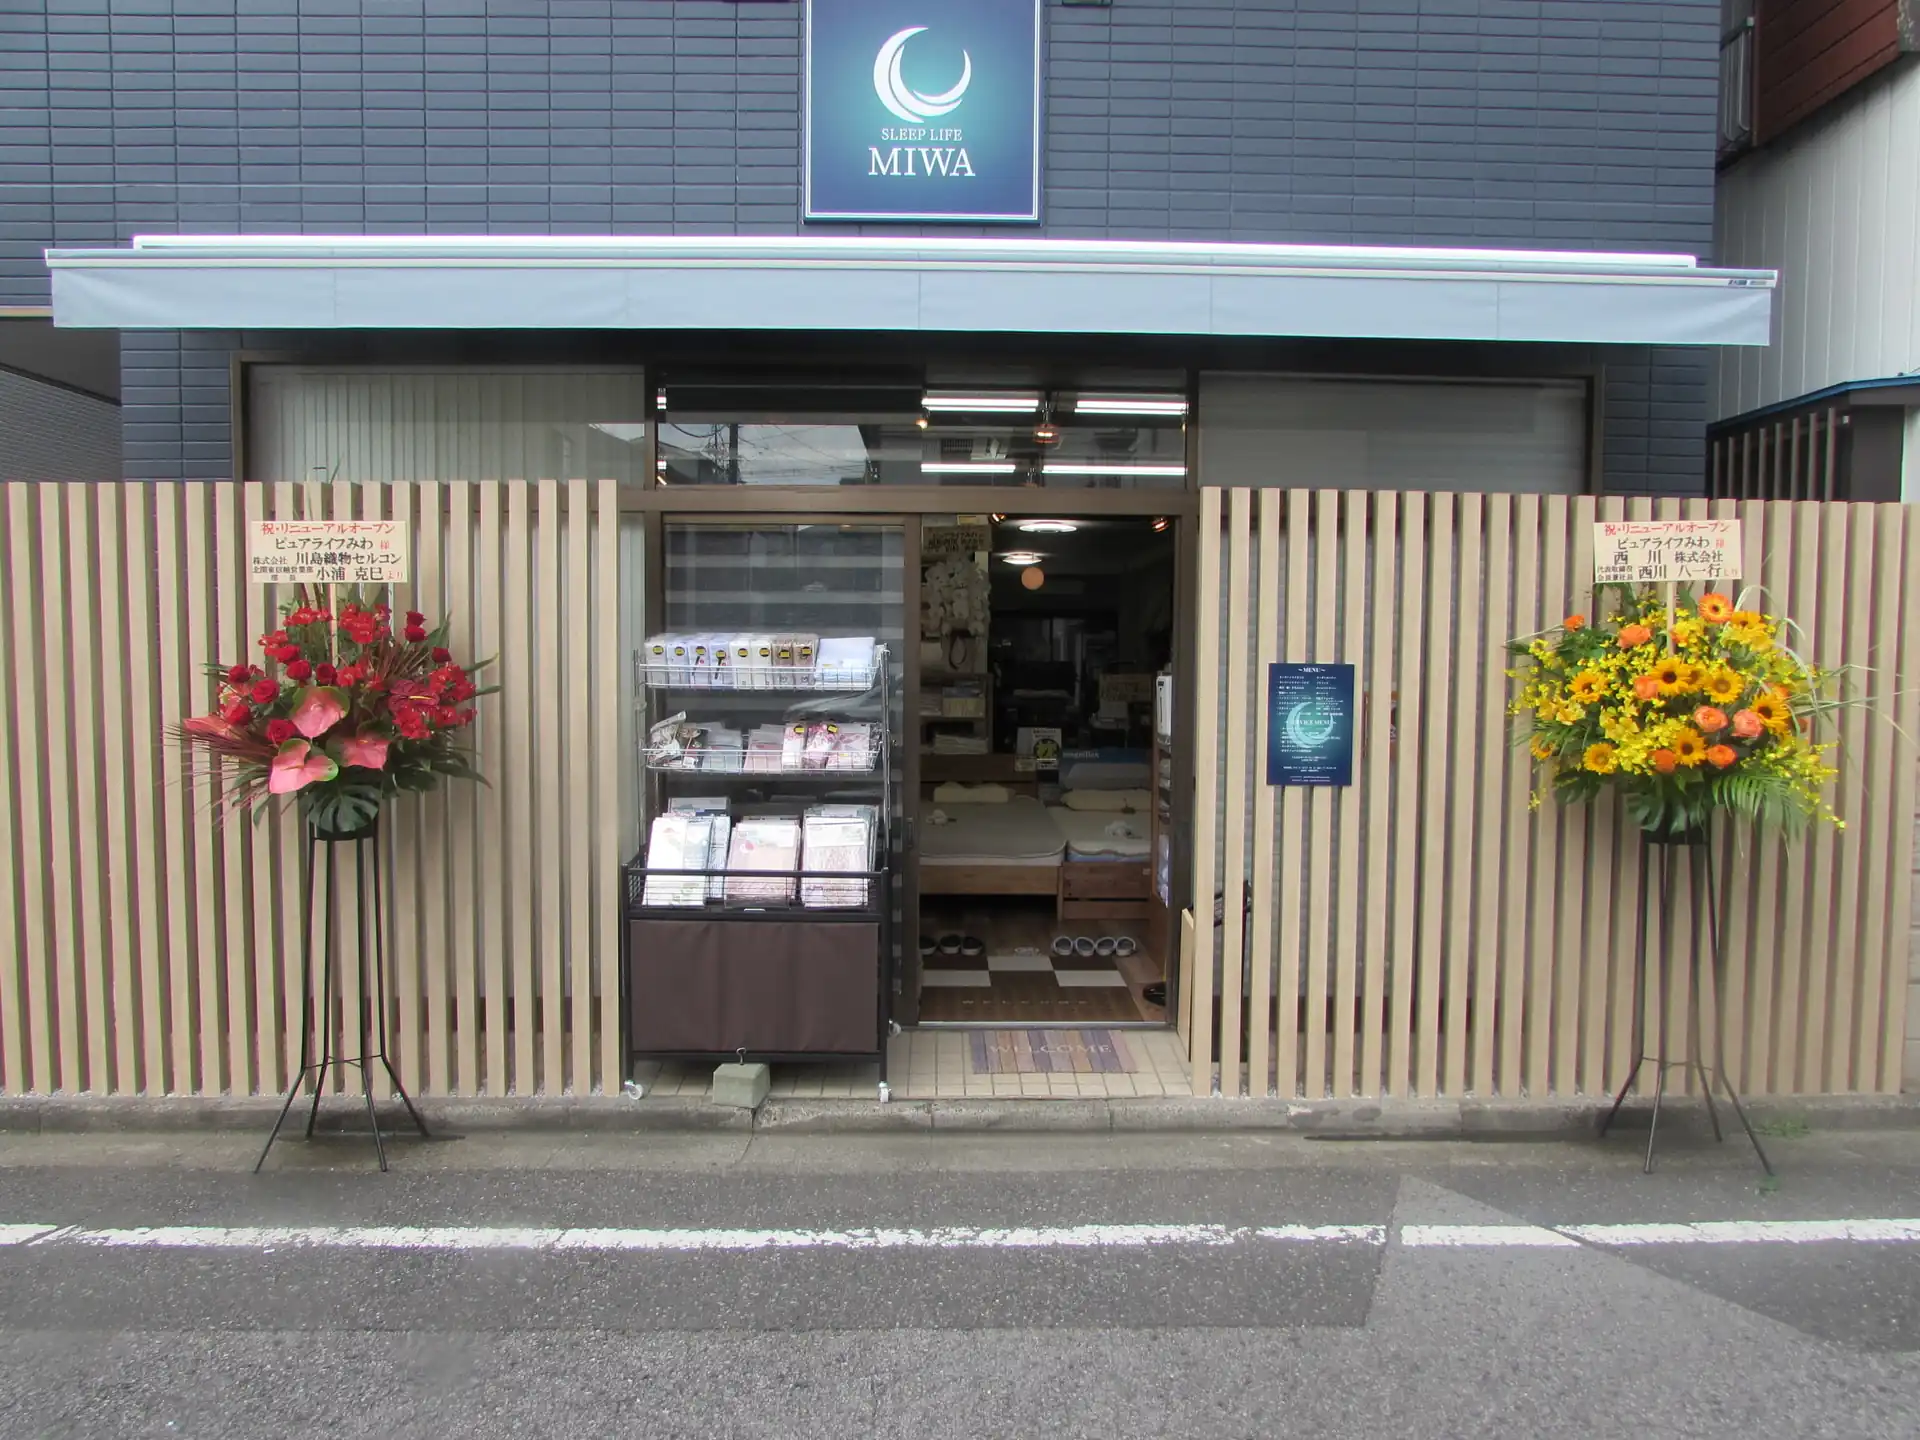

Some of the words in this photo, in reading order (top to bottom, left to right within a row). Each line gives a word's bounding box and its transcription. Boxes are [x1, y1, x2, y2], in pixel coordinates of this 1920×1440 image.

[881, 128, 926, 141] SLEEP
[930, 129, 963, 142] LIFE
[868, 147, 976, 177] MIWA
[275, 537, 374, 550] ピュアライフみわ
[253, 556, 288, 565] 株式会社
[295, 552, 402, 565] 川島織物セルコン
[1674, 550, 1724, 563] 株式会社
[316, 566, 346, 581] 小浦
[1638, 564, 1667, 579] 西川
[989, 1044, 1112, 1054] WELCOME
